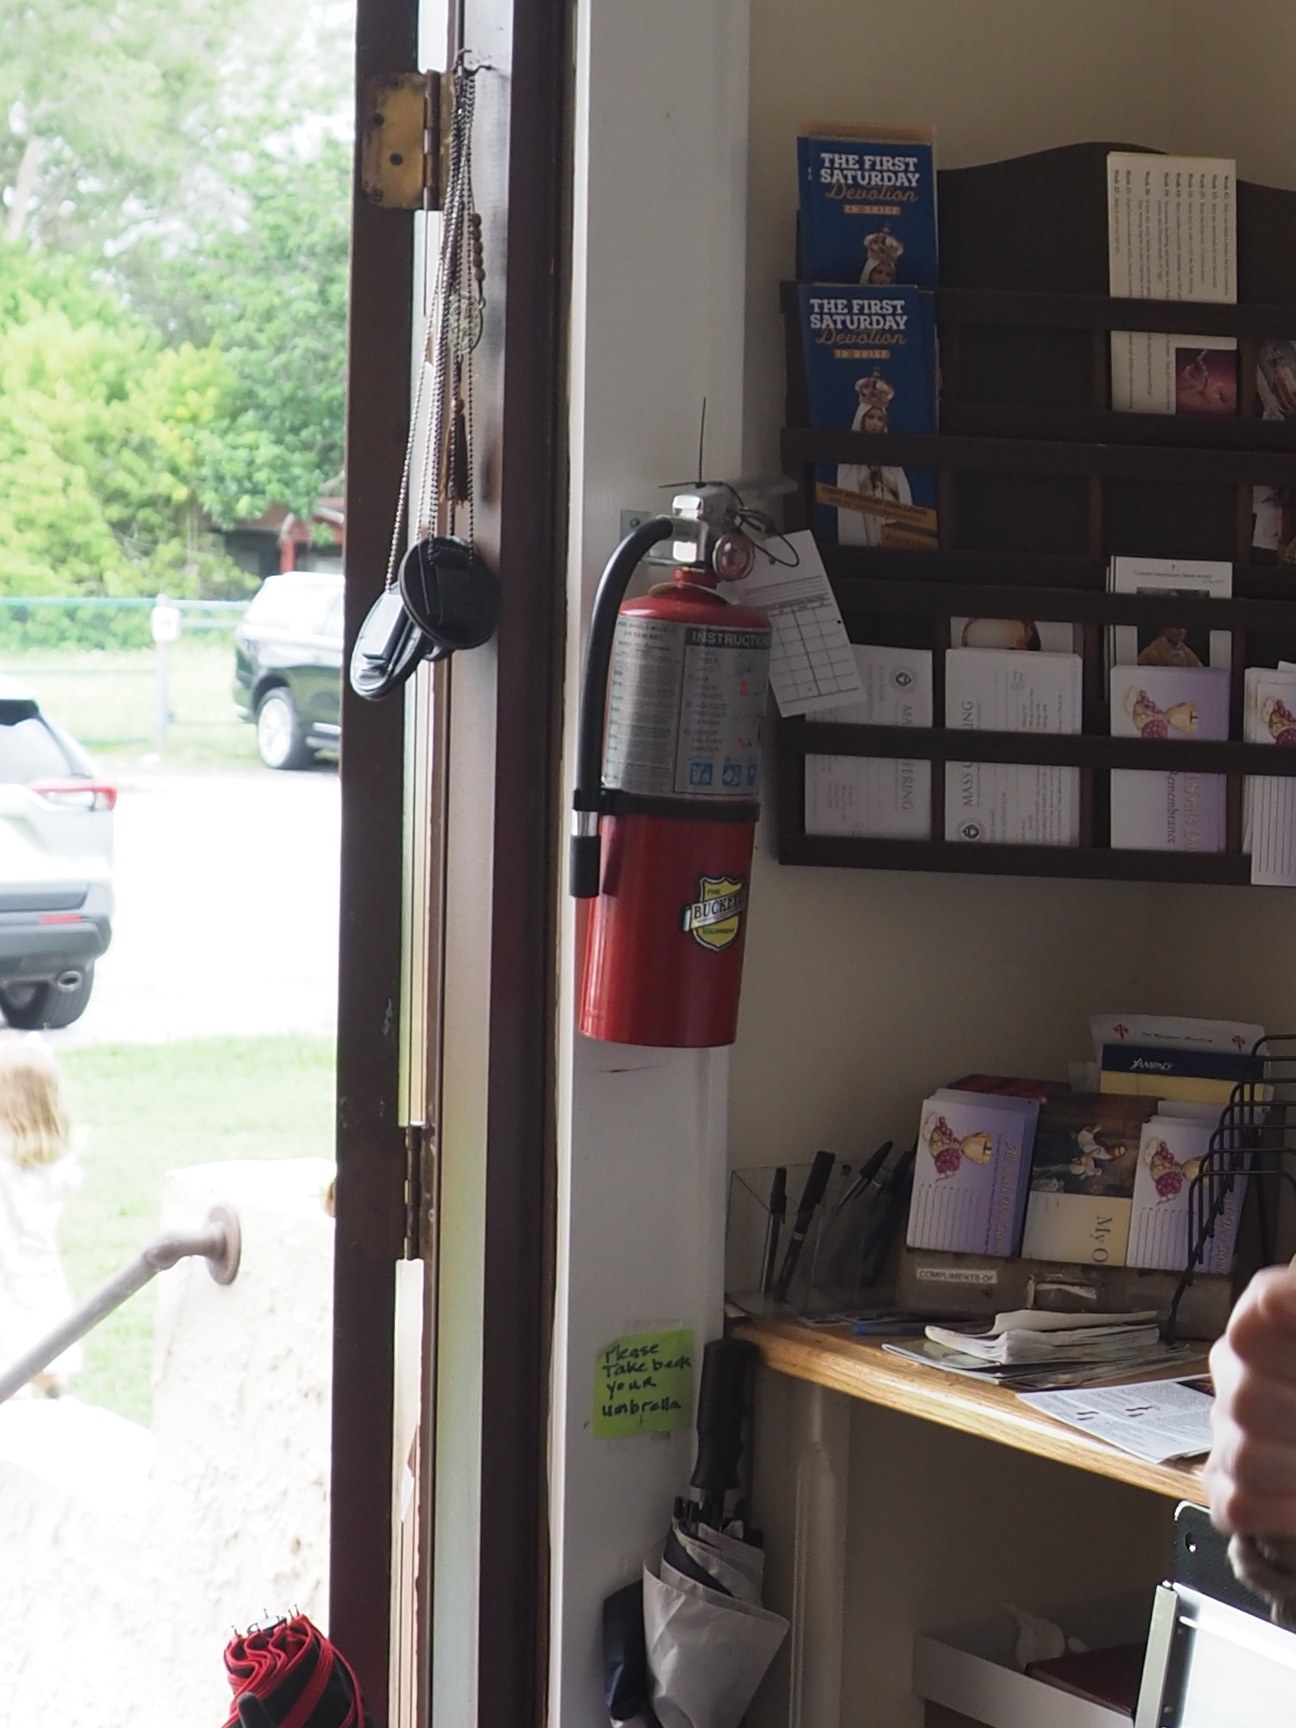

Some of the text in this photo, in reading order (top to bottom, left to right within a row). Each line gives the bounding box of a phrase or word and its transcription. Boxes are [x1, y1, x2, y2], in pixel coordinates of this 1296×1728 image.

[820, 153, 918, 172] THE FIRST
[820, 169, 920, 187] SATURDAY
[825, 181, 918, 202] Devotion
[809, 299, 905, 315] THE FIRST
[809, 314, 909, 330] SATURDAY
[815, 328, 907, 345] Devotion
